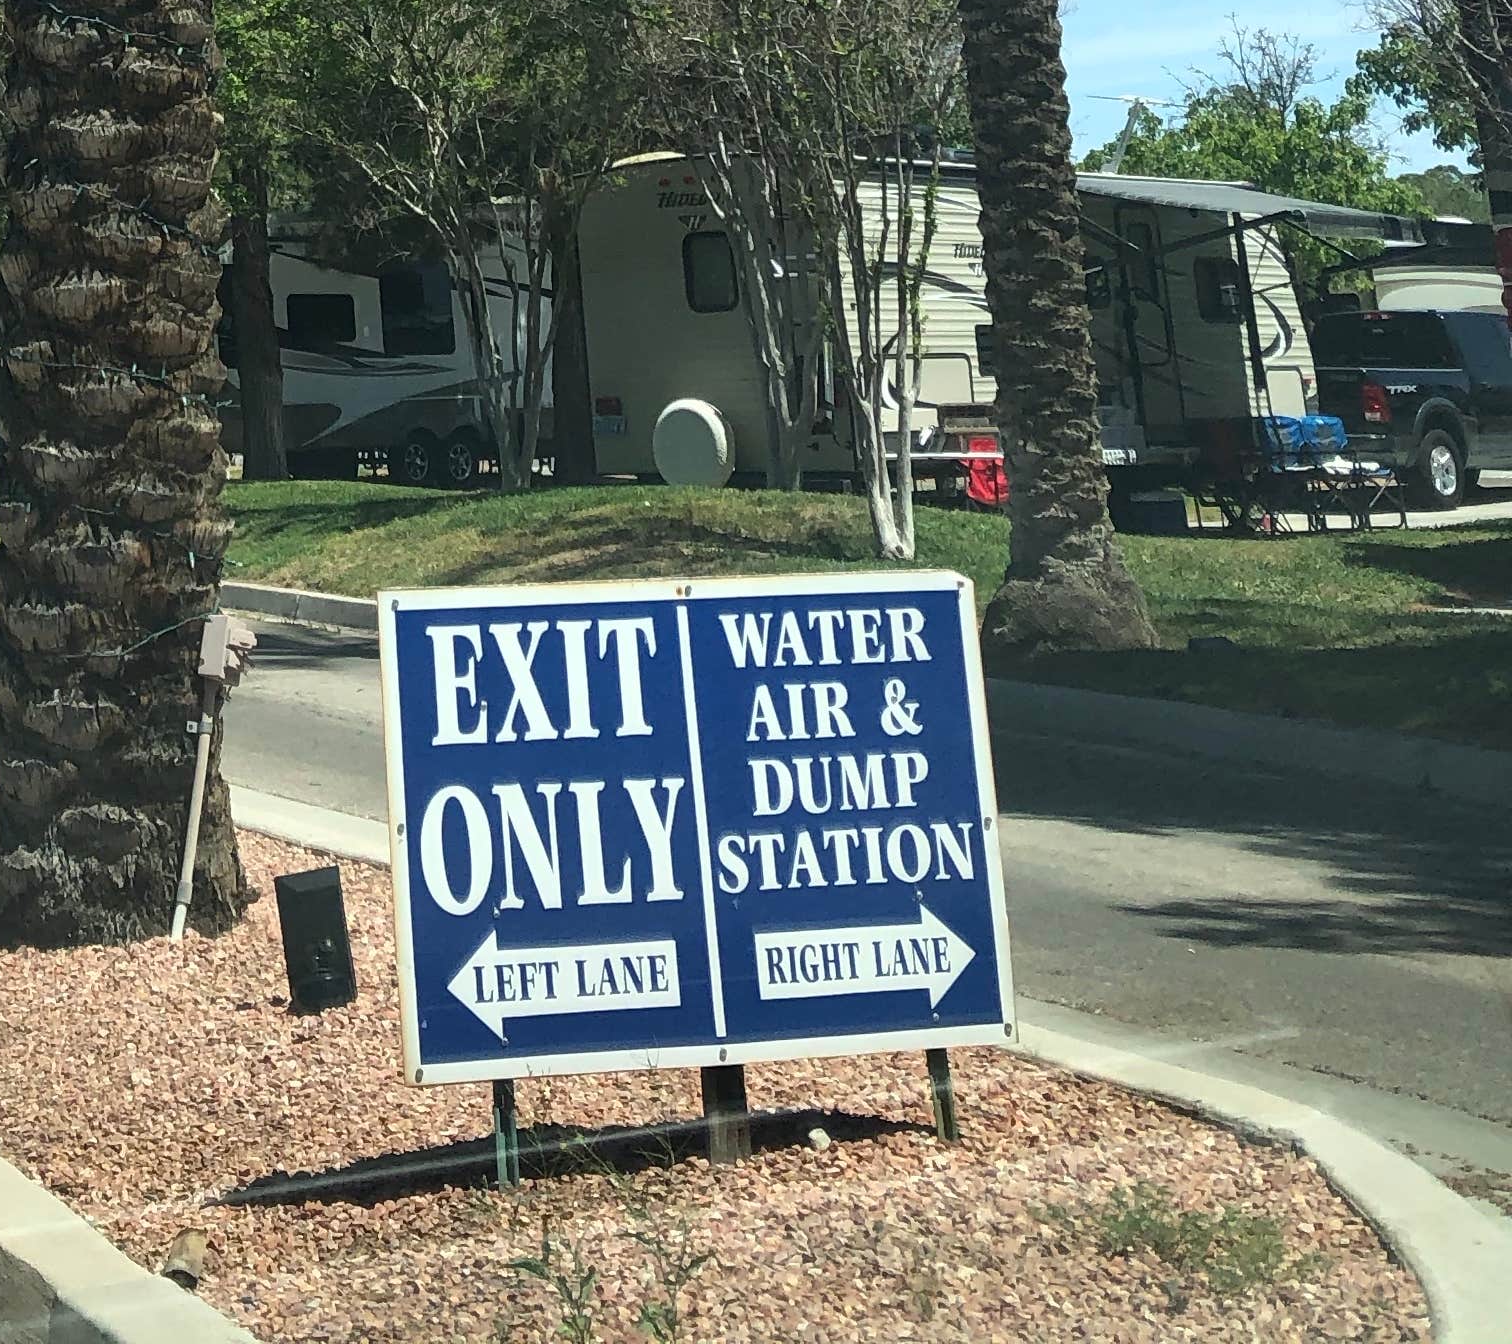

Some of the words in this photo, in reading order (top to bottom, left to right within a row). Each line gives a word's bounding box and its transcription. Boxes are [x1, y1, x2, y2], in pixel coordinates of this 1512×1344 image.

[719, 608, 931, 667] WATER
[426, 617, 656, 745] EXIT
[747, 682, 856, 741] AIR
[881, 678, 923, 736] &
[748, 753, 928, 815] DUMP
[420, 778, 684, 916] ONLY
[718, 823, 973, 893] STATION
[473, 961, 560, 1004] LEFT
[575, 955, 669, 997] LANE
[764, 942, 860, 984] RIGHT
[872, 937, 951, 978] LANE
